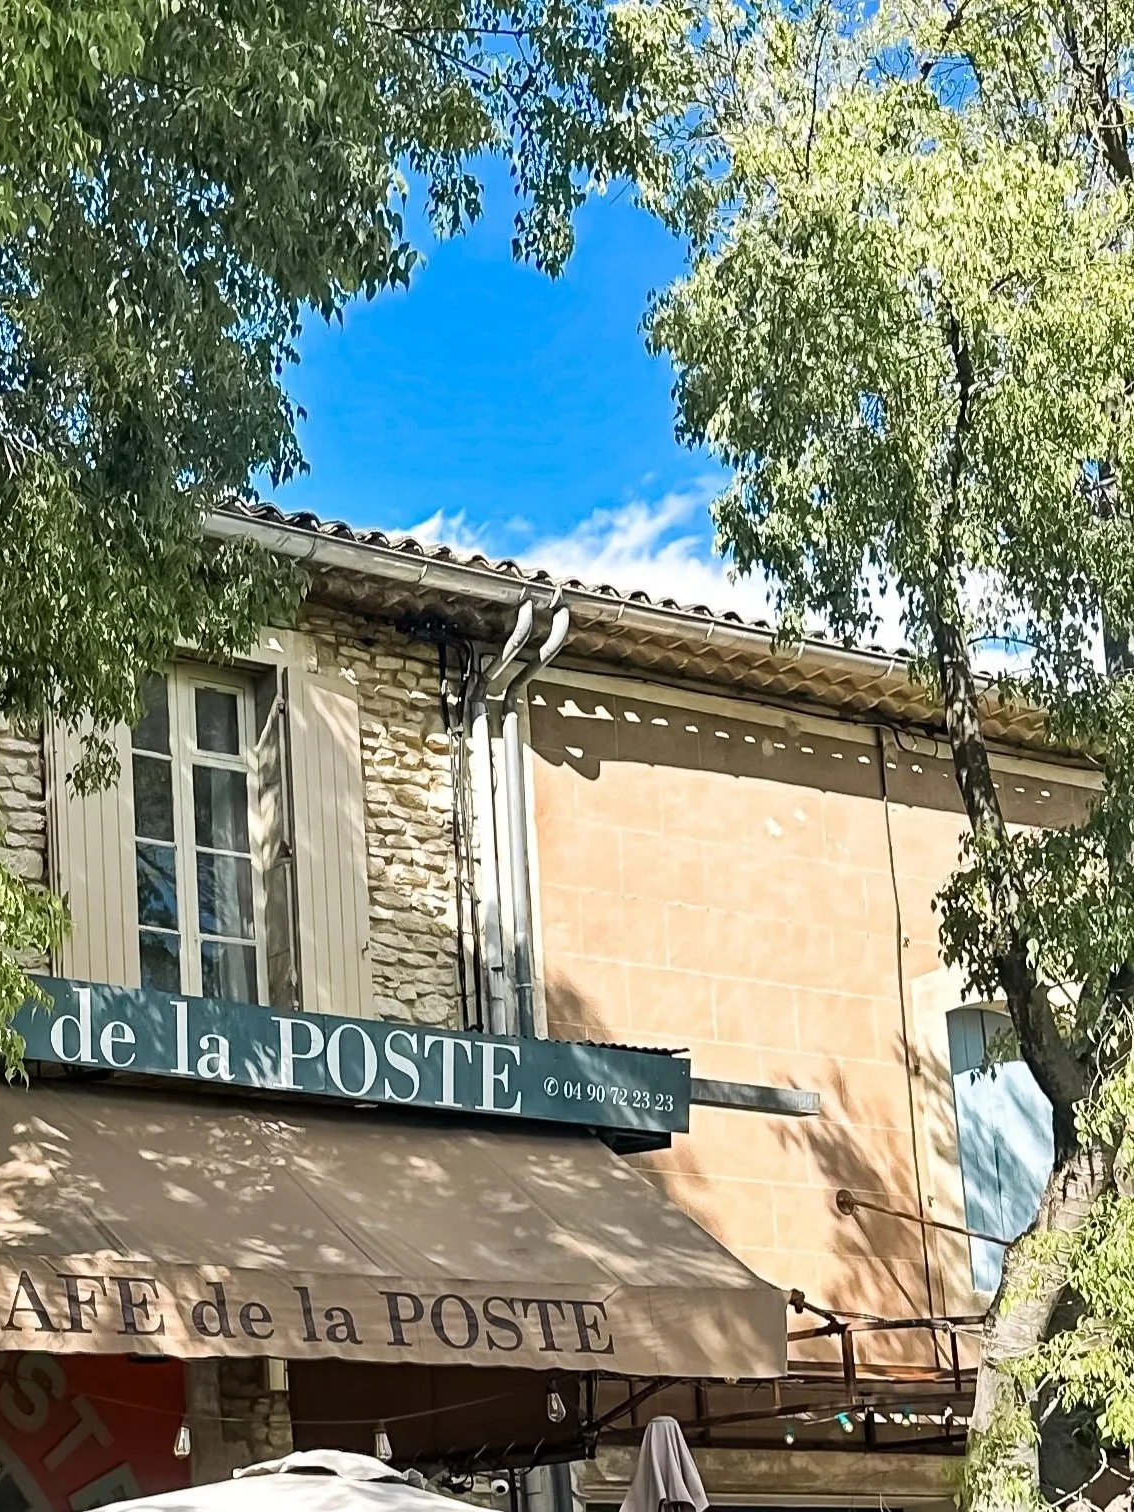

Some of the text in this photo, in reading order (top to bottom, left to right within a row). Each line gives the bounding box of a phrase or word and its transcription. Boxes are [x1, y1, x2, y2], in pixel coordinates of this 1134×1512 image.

[50, 987, 674, 1114] de la POSTE 04 90 72 23 23
[191, 1281, 277, 1341] de
[293, 1286, 363, 1345] la
[379, 1290, 617, 1355] POSTE
